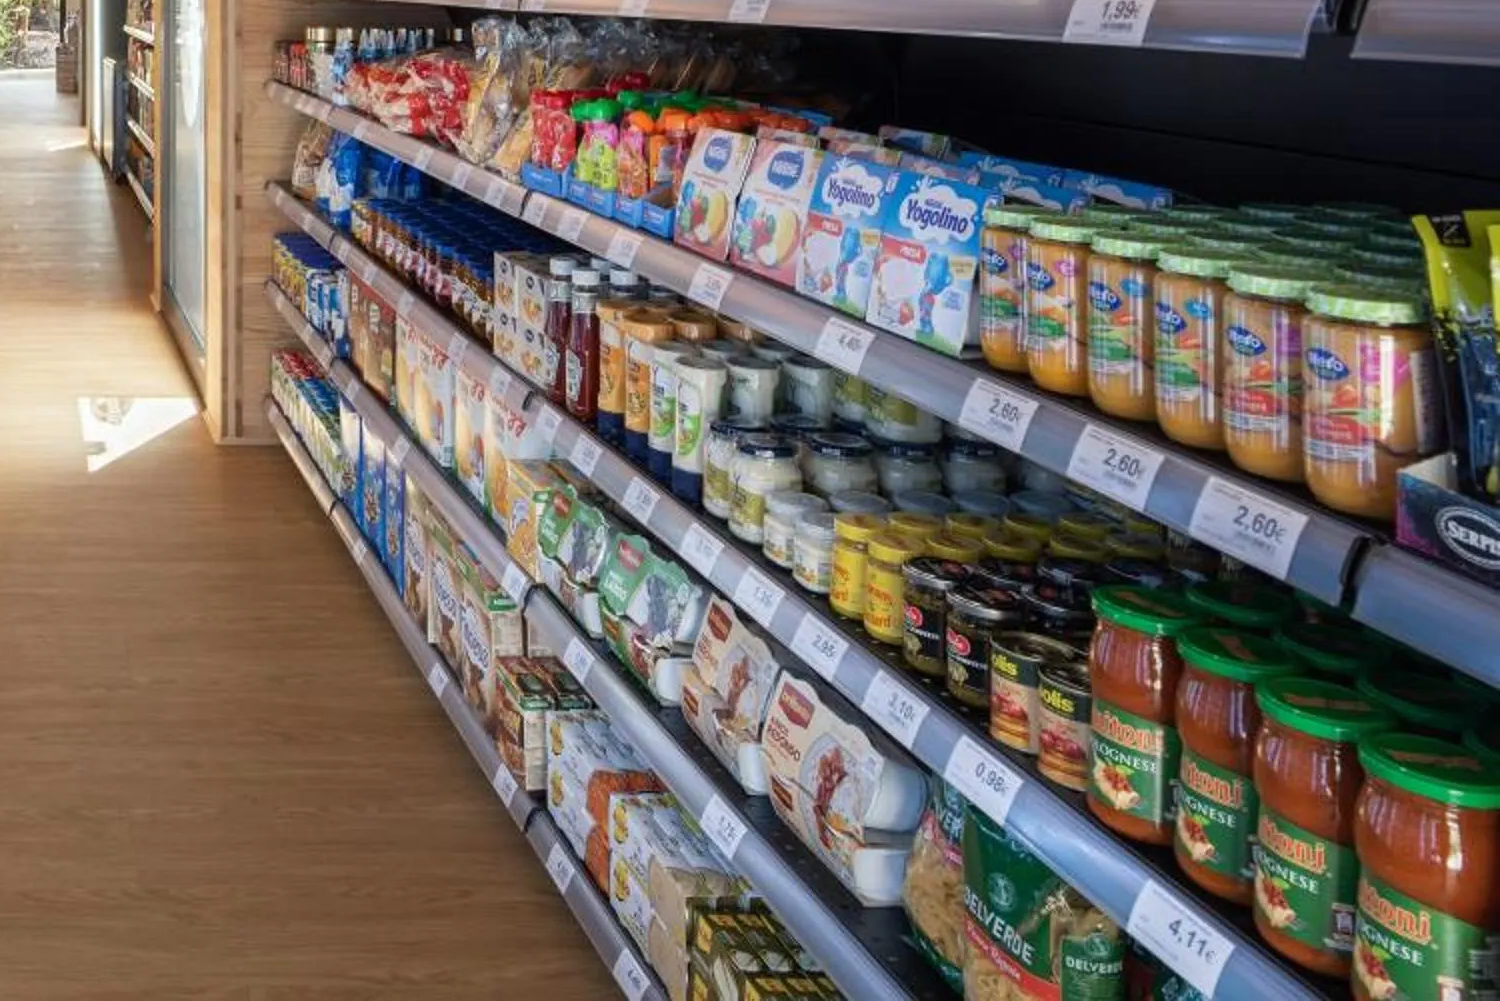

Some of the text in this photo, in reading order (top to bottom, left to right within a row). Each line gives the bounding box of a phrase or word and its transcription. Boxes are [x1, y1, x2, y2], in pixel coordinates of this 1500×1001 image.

[828, 177, 875, 209] Yogolino
[907, 199, 969, 234] Yogolino
[1233, 505, 1287, 543] 2,60€
[964, 886, 1036, 966] DELVERDE
[1168, 918, 1217, 963] 4,11€
